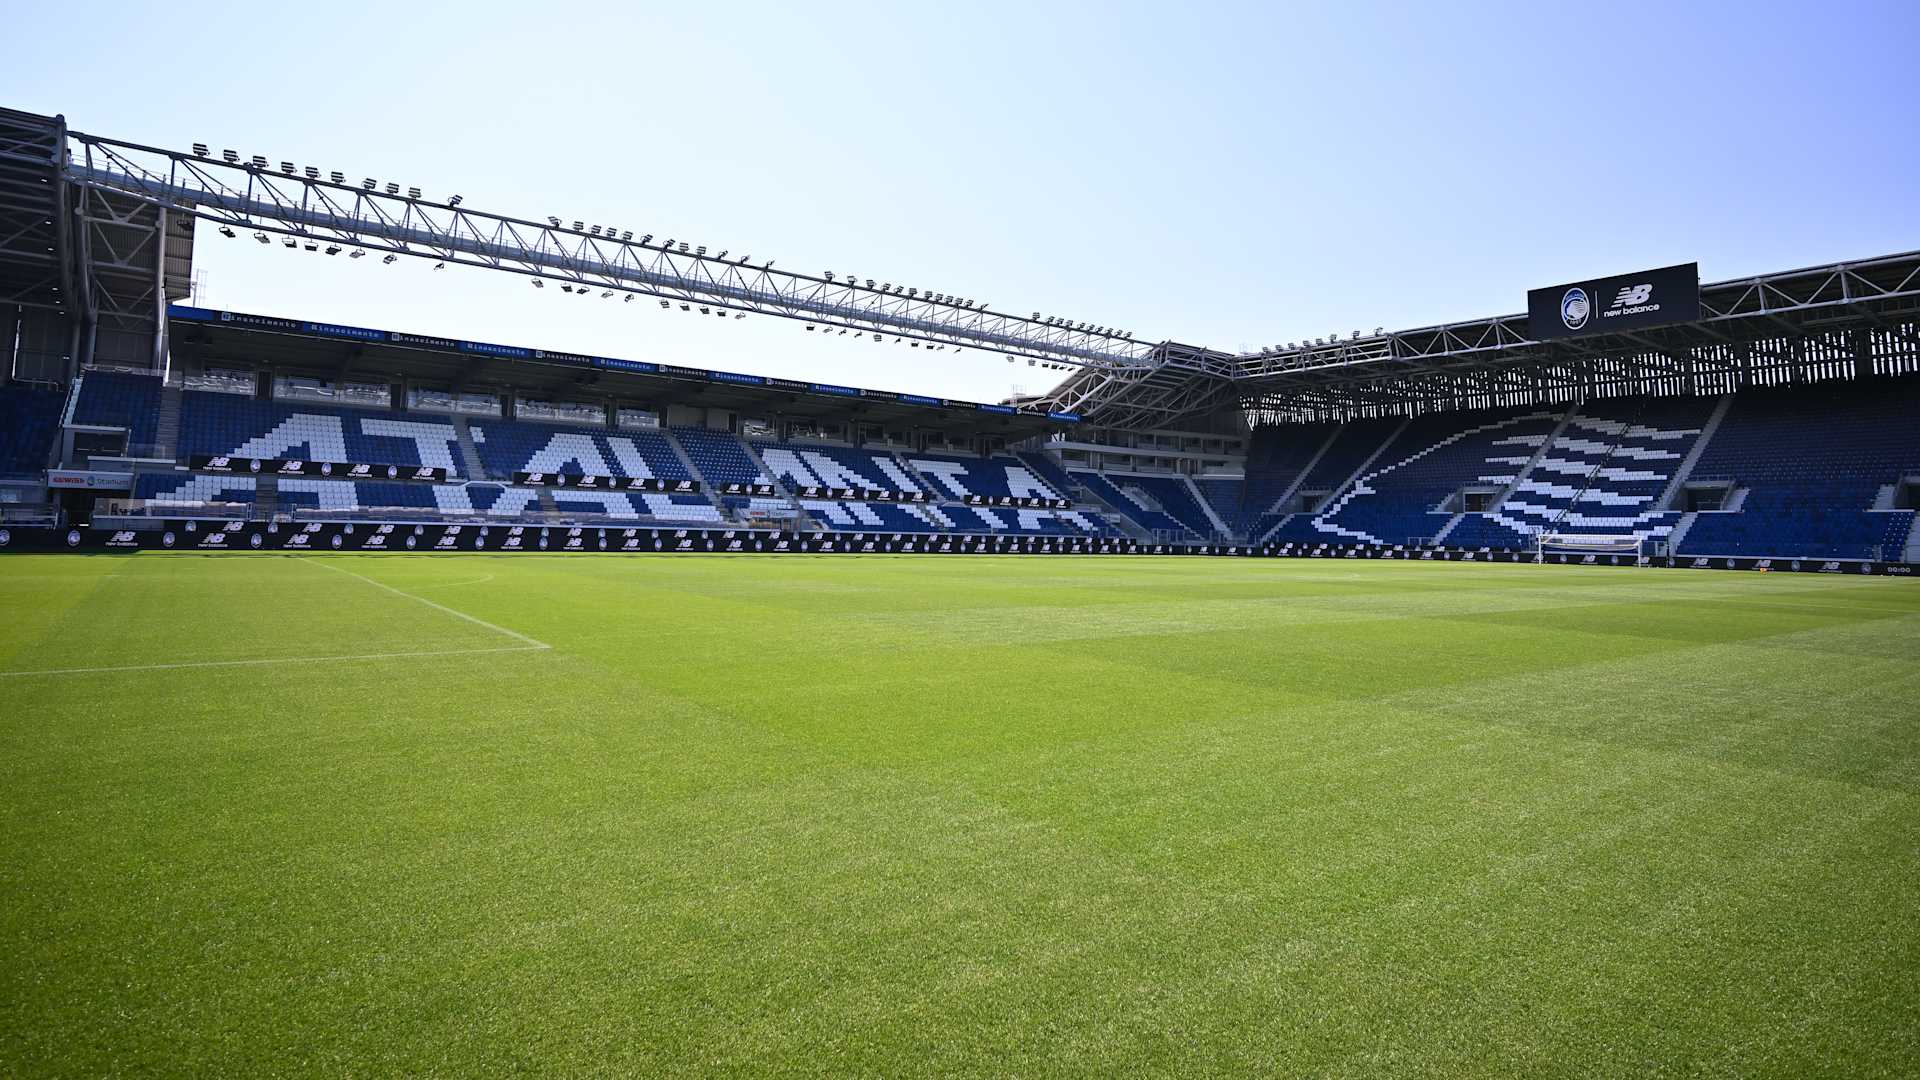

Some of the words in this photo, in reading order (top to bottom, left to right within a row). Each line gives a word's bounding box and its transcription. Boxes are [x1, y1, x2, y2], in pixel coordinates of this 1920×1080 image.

[1611, 283, 1653, 308] NB
[1603, 310, 1621, 318] new
[1623, 303, 1660, 316] balance
[208, 457, 230, 466] NB
[282, 461, 302, 470] NB
[351, 464, 370, 473] NB
[223, 521, 244, 531] NB
[302, 523, 322, 532] NB
[376, 525, 394, 533] NB
[111, 531, 136, 542] NB
[203, 533, 226, 543] NB
[289, 534, 309, 544] NB
[366, 535, 385, 544] NB
[438, 536, 456, 545] NB
